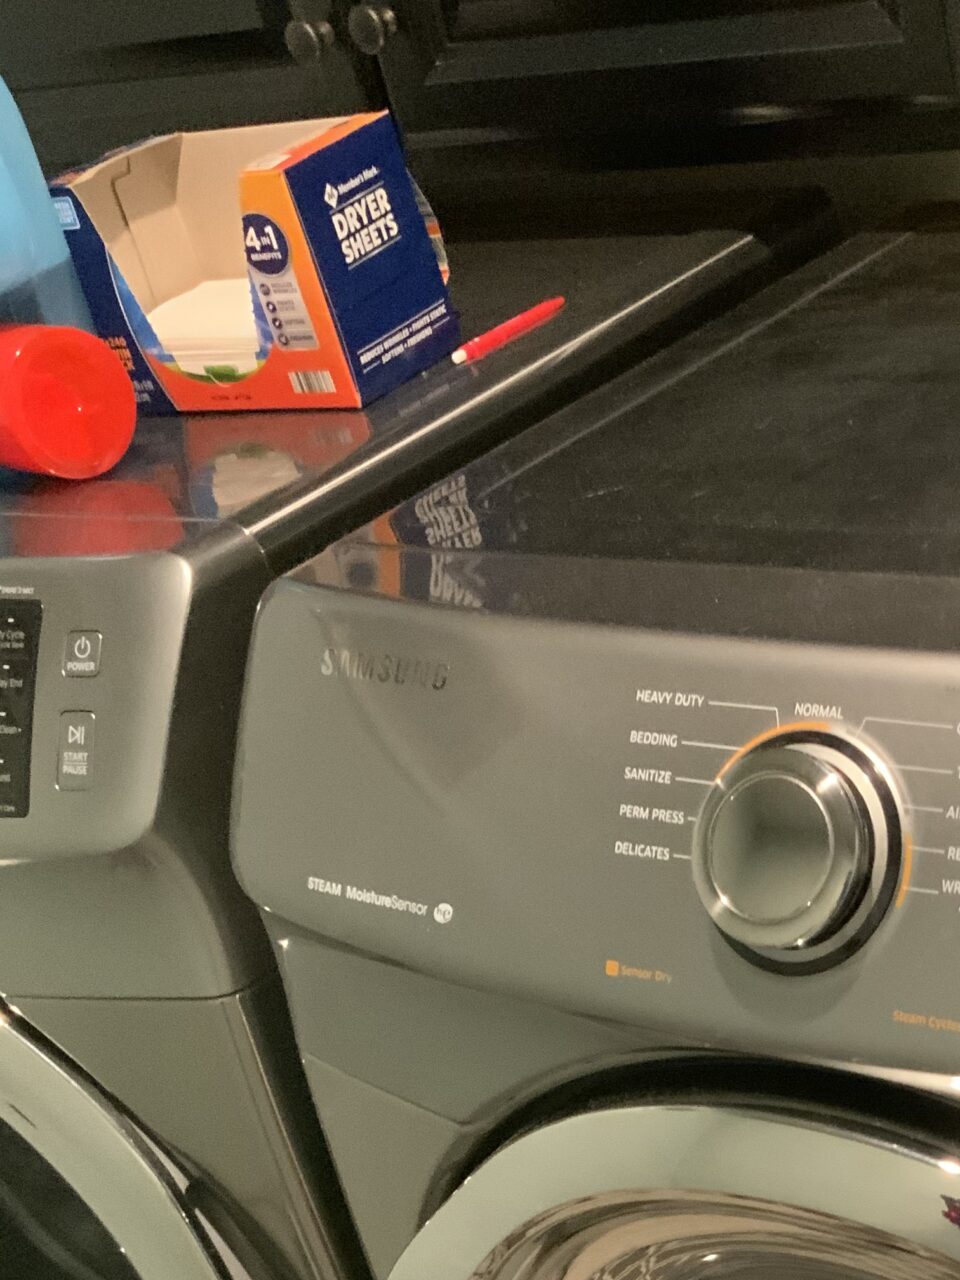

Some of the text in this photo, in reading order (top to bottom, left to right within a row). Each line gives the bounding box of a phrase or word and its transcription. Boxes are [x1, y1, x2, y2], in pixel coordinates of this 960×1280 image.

[331, 187, 391, 241] DRYER
[245, 226, 261, 251] 4
[264, 225, 279, 250] 1
[341, 212, 399, 264] SHEETS
[67, 661, 96, 671] POWER
[321, 648, 450, 690] SAMSUNG
[636, 689, 705, 708] HEAVY DUTY
[795, 702, 844, 720] NORMAL
[630, 730, 678, 748] BEDDING
[63, 752, 88, 762] START
[62, 764, 88, 775] PAUSE
[624, 767, 672, 784] SANITIZE
[619, 803, 684, 824] PERM PRESS
[614, 841, 670, 860] DELICATES
[307, 876, 342, 897] STEAM
[346, 885, 428, 916] MoistureSensor
